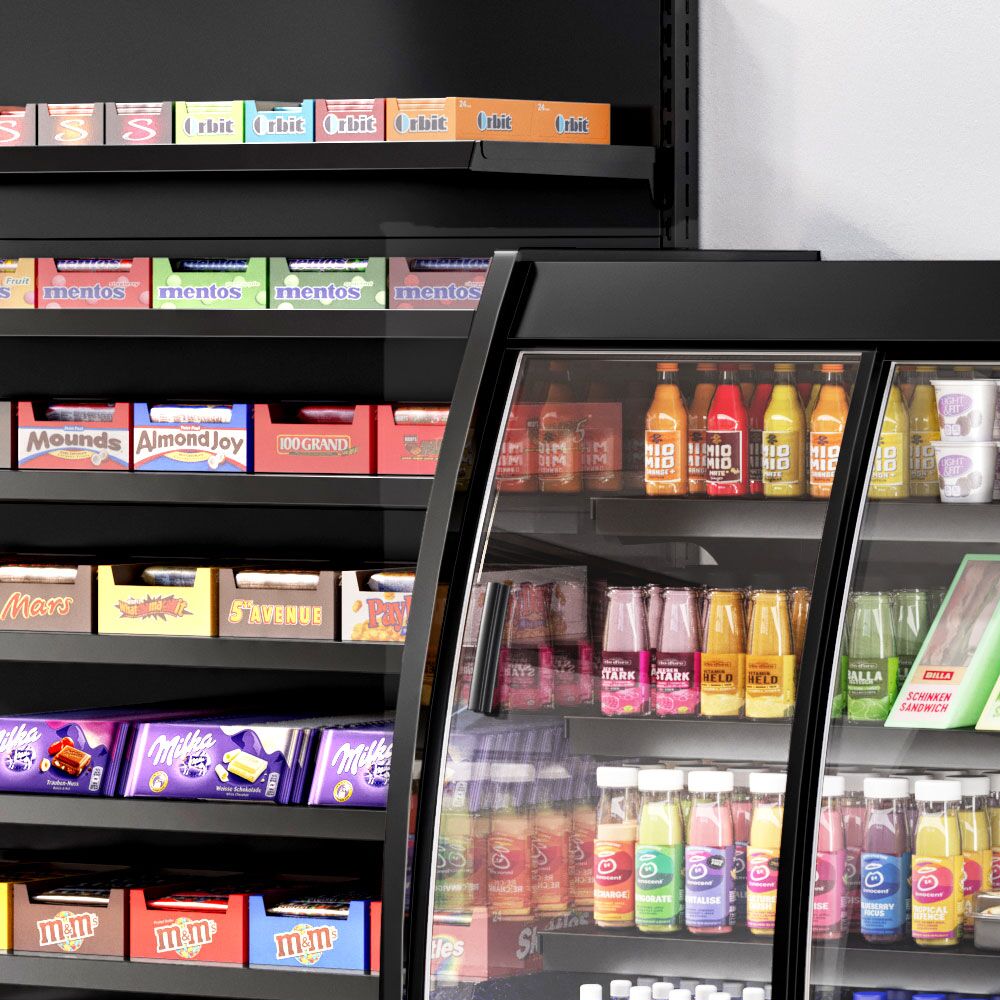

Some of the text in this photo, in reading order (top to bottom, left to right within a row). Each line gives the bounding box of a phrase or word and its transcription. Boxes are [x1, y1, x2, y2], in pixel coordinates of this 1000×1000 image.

[183, 115, 235, 137] Orbit
[252, 114, 306, 136] Orbit
[322, 113, 378, 136] Orbit
[393, 111, 449, 135] Orbit
[476, 110, 513, 133] Orbit
[554, 113, 590, 135] Orbit
[5, 277, 30, 286] Fruit
[43, 284, 127, 301] mentos
[158, 284, 243, 301] mentos
[274, 284, 362, 301] mentos
[394, 284, 482, 301] mentos
[26, 430, 123, 453] Mounds
[135, 430, 244, 456] Almond Joy
[279, 436, 350, 451] 100 GRAND
[0, 591, 74, 621] Mars
[249, 605, 323, 626] AVENUE
[703, 673, 734, 683] HELD
[748, 675, 779, 685] HELD
[906, 691, 953, 702] SCHINKEN
[899, 702, 949, 713] SANDWICH
[147, 728, 217, 768] Milka
